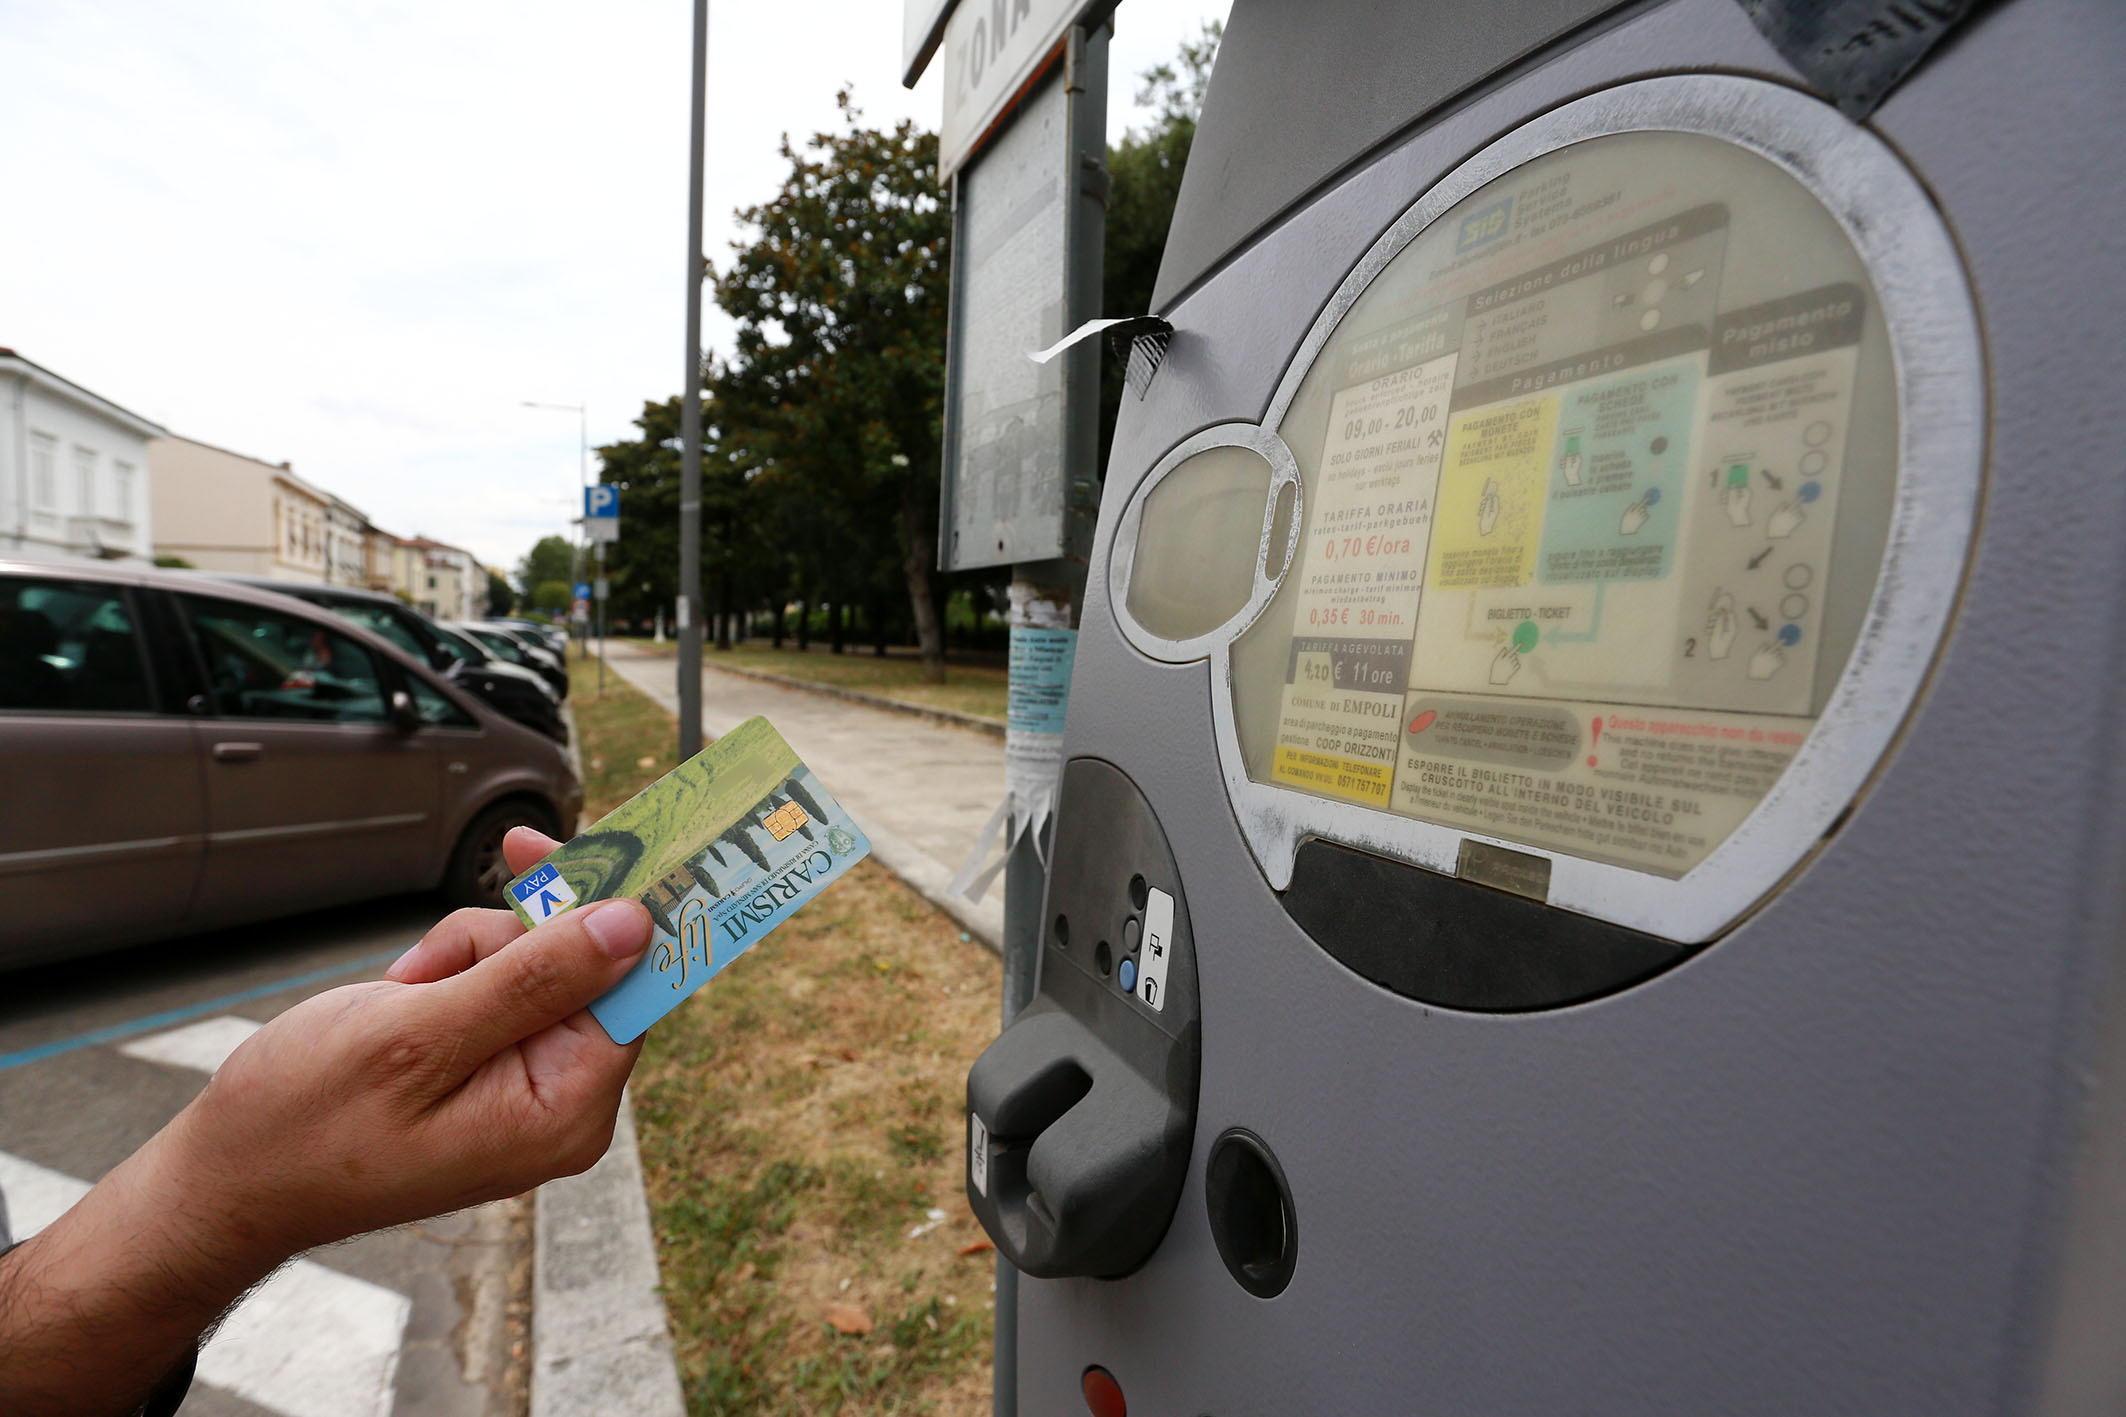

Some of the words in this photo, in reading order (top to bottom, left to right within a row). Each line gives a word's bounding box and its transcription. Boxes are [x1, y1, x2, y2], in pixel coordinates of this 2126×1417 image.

[1474, 274, 1553, 308] Selezione
[1560, 254, 1605, 278] della
[1614, 225, 1680, 258] lingua
[1491, 300, 1545, 326] ITALIANO
[1722, 302, 1850, 345] Pagamento
[1487, 334, 1537, 358] ENGLISH
[1484, 352, 1538, 374] DEUTSCH
[1511, 354, 1624, 391] Pagamento
[1372, 367, 1423, 391] ORARIO
[1651, 375, 1679, 390] CON
[1345, 418, 1382, 442] 09,00
[1394, 403, 1438, 430] 20,00
[1462, 412, 1517, 432] PAGAMENTO
[1519, 407, 1541, 421] CON
[1480, 423, 1519, 438] MONETE
[1330, 453, 1352, 466] SOLO
[1354, 445, 1383, 462] GIORNI
[1385, 437, 1420, 454] FERIALI
[1709, 468, 1719, 488] 1
[590, 487, 612, 516] P
[1324, 506, 1371, 523] TARIFFA
[1377, 498, 1428, 516] ORARIA
[1325, 537, 1362, 562] 0,70
[1365, 534, 1410, 557] €/ora
[1312, 572, 1372, 585] PAGAMENTO
[1376, 570, 1417, 582] MINIMO
[1310, 608, 1338, 627] 0,35
[1341, 608, 1349, 624] €
[1360, 609, 1375, 624] 30
[1378, 612, 1404, 625] min.
[1487, 608, 1532, 620] BIGLIETTO
[1538, 606, 1572, 619] TICKET
[1300, 641, 1339, 652] TARIFFA
[1342, 644, 1405, 656] AGEVOLATA
[1684, 638, 1696, 658] 2
[1334, 660, 1344, 680] €
[1353, 661, 1369, 682] 11
[1371, 669, 1393, 684] ore
[1291, 696, 1327, 710] COMUNE
[1343, 699, 1398, 718] EMPOLI
[1316, 737, 1341, 751] COOP
[1353, 728, 1398, 742] pagamento
[1337, 774, 1356, 788] 0571
[1342, 762, 1383, 779] TELEFONARE
[1408, 758, 1454, 775] ESPORRE
[1458, 765, 1467, 777] IL
[1471, 768, 1533, 787] BIGLIETTO
[1538, 777, 1550, 789] IN
[1556, 781, 1595, 798] MODO
[1600, 787, 1664, 810] VISIBILE
[1671, 799, 1702, 816] SUL
[1421, 774, 1483, 792] CRUSCOTTO
[1575, 797, 1599, 813] DEL
[1607, 802, 1674, 825] VEICOLO
[802, 840, 819, 856] CASSA
[767, 857, 797, 881] RISPARMIO
[523, 871, 550, 895] PAY
[708, 894, 731, 913] CARISMI
[720, 851, 832, 944] CARISMI
[727, 890, 752, 913] MINIATO
[650, 898, 713, 990] life
